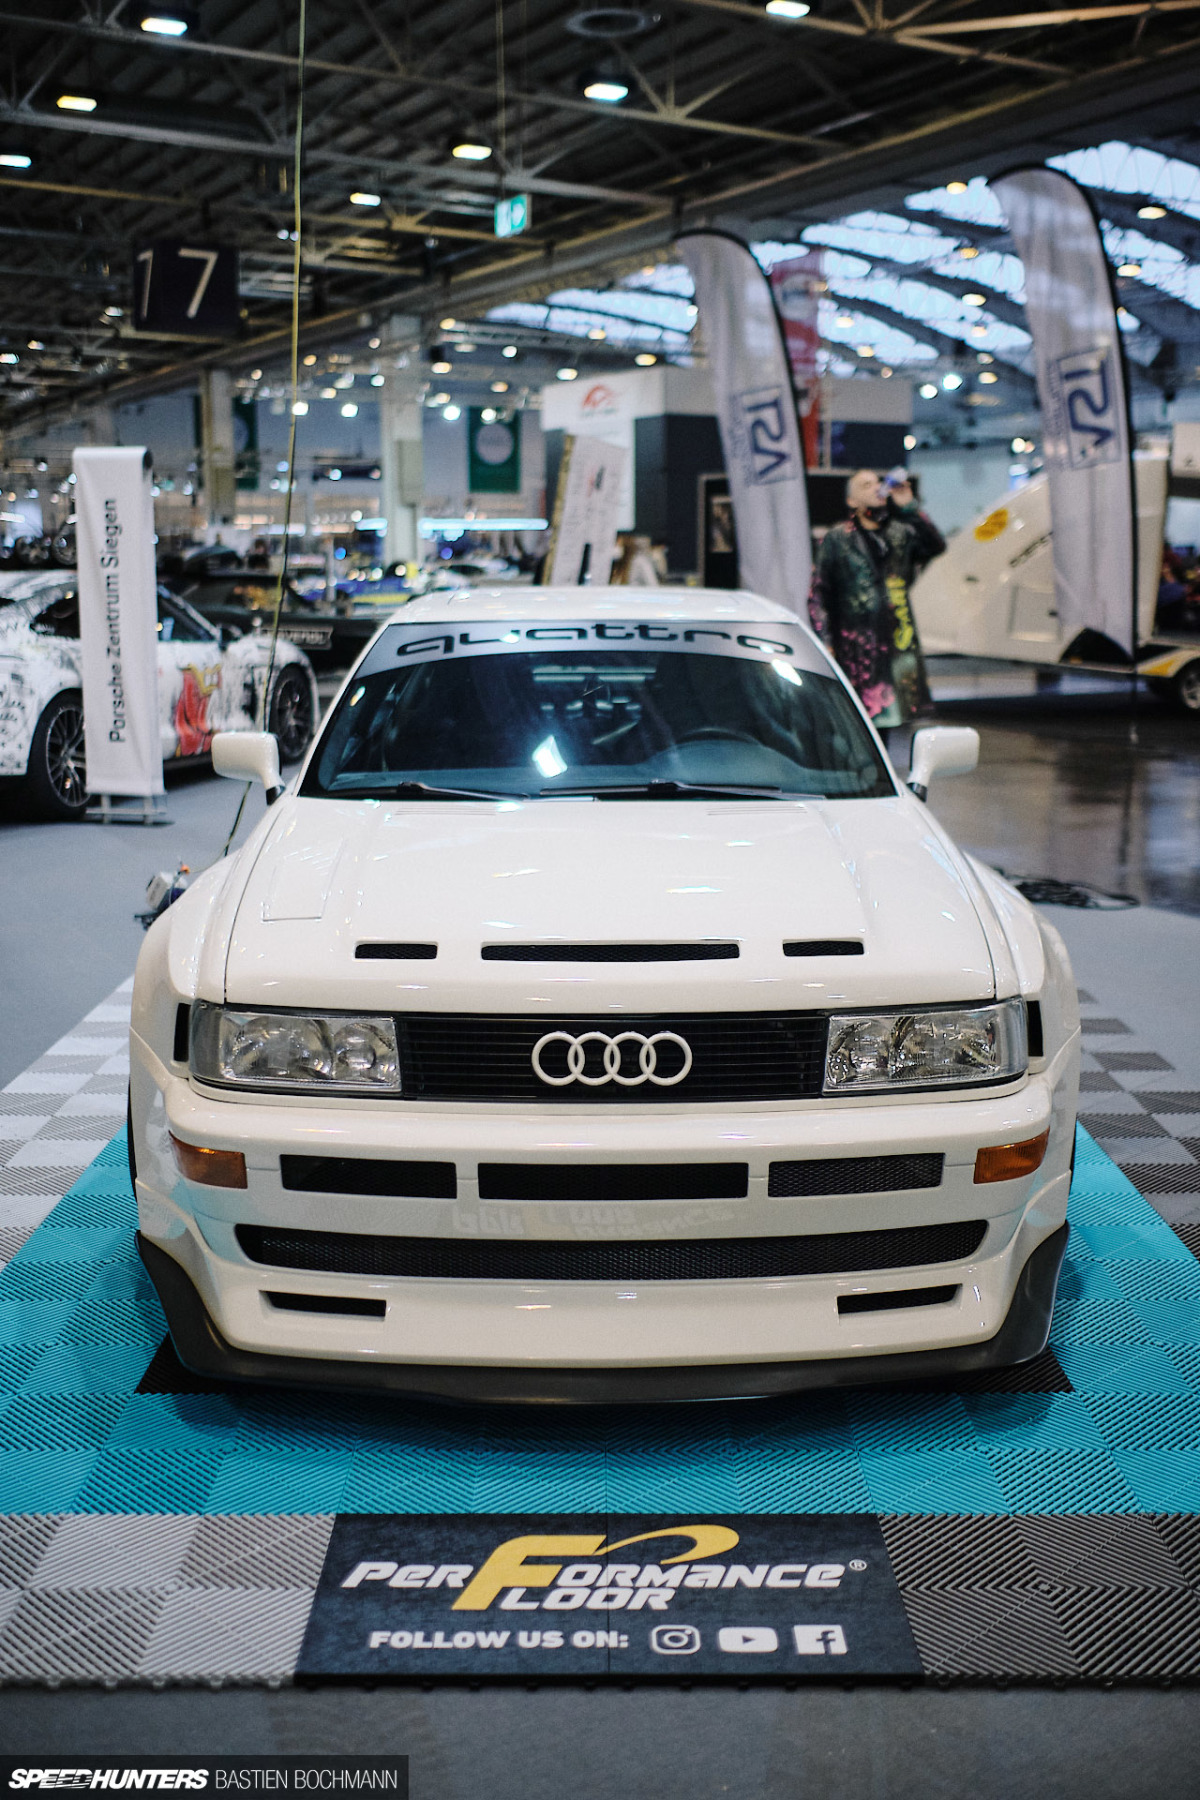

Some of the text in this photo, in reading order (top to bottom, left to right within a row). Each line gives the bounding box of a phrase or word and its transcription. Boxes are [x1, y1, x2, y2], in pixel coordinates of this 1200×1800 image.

[137, 248, 219, 320] 17
[101, 498, 126, 743] Porsche Zentrum Siegen
[396, 623, 794, 657] quattro
[368, 1630, 630, 1650] FOLLOW US ON:
